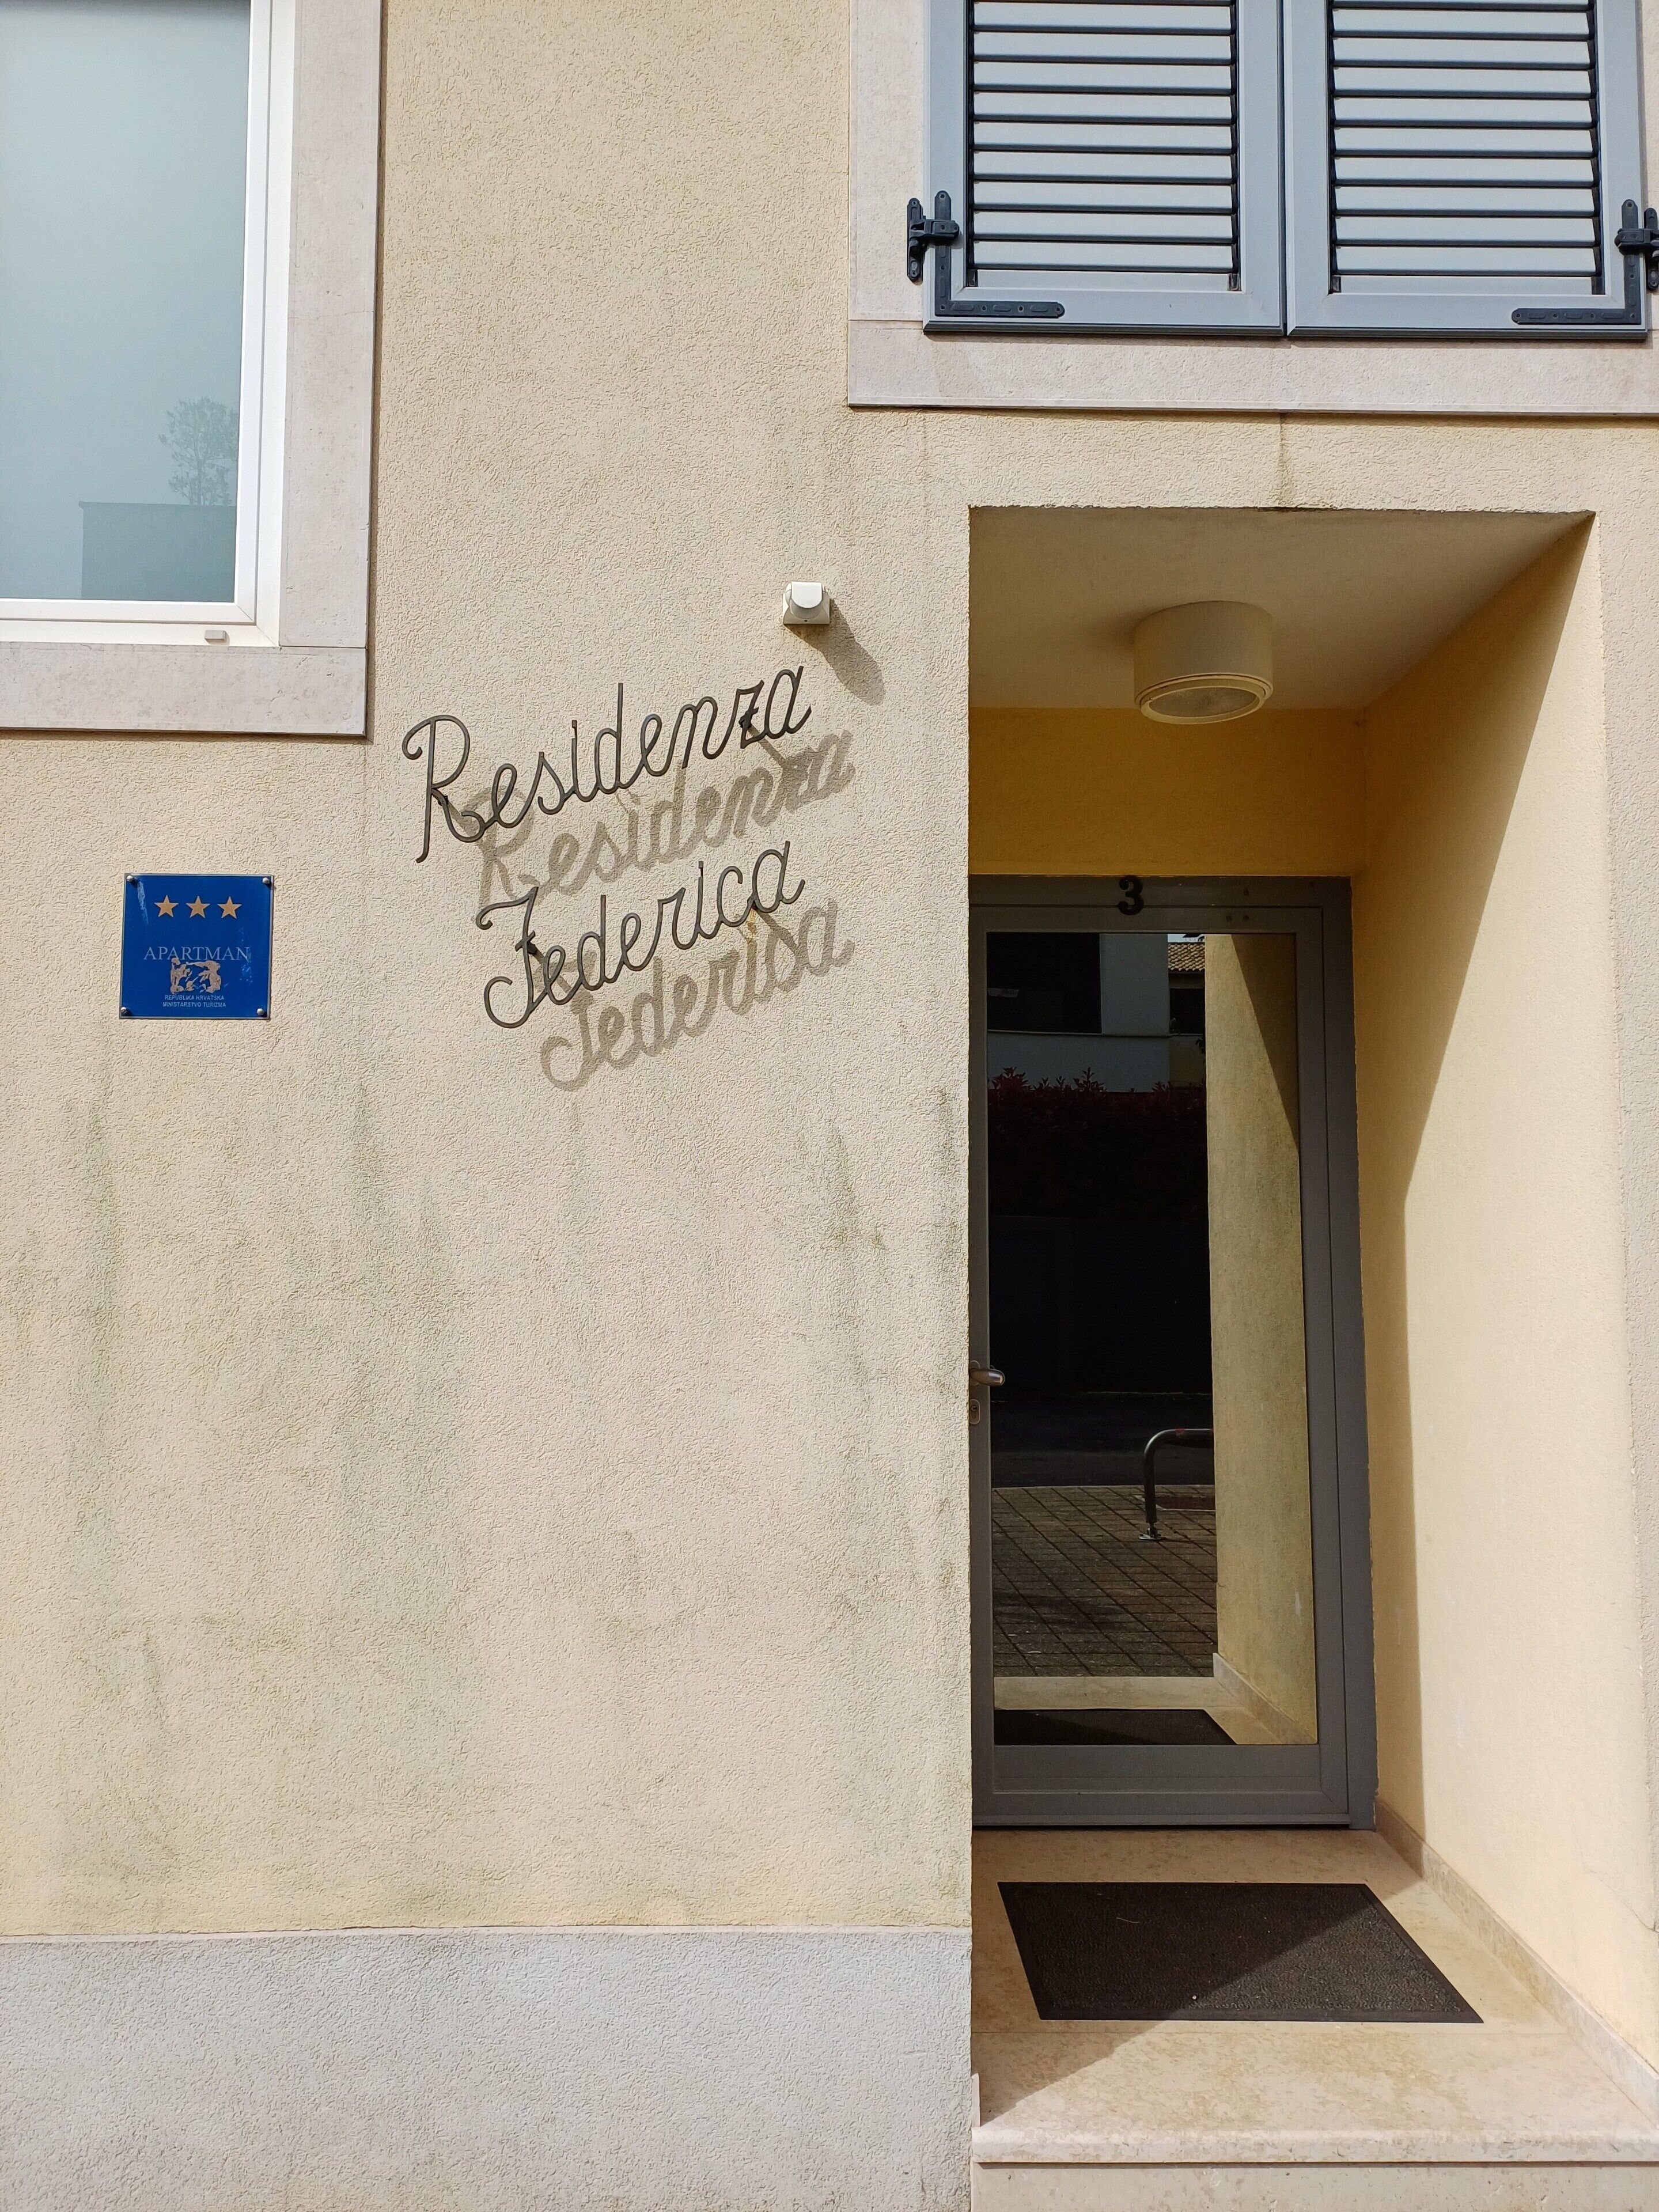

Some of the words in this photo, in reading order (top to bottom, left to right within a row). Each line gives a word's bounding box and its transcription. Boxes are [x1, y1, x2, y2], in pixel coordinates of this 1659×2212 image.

[402, 666, 812, 863] Residenza
[476, 840, 805, 1029] Federica
[1118, 875, 1144, 915] 3
[143, 946, 250, 961] APARTMAN
